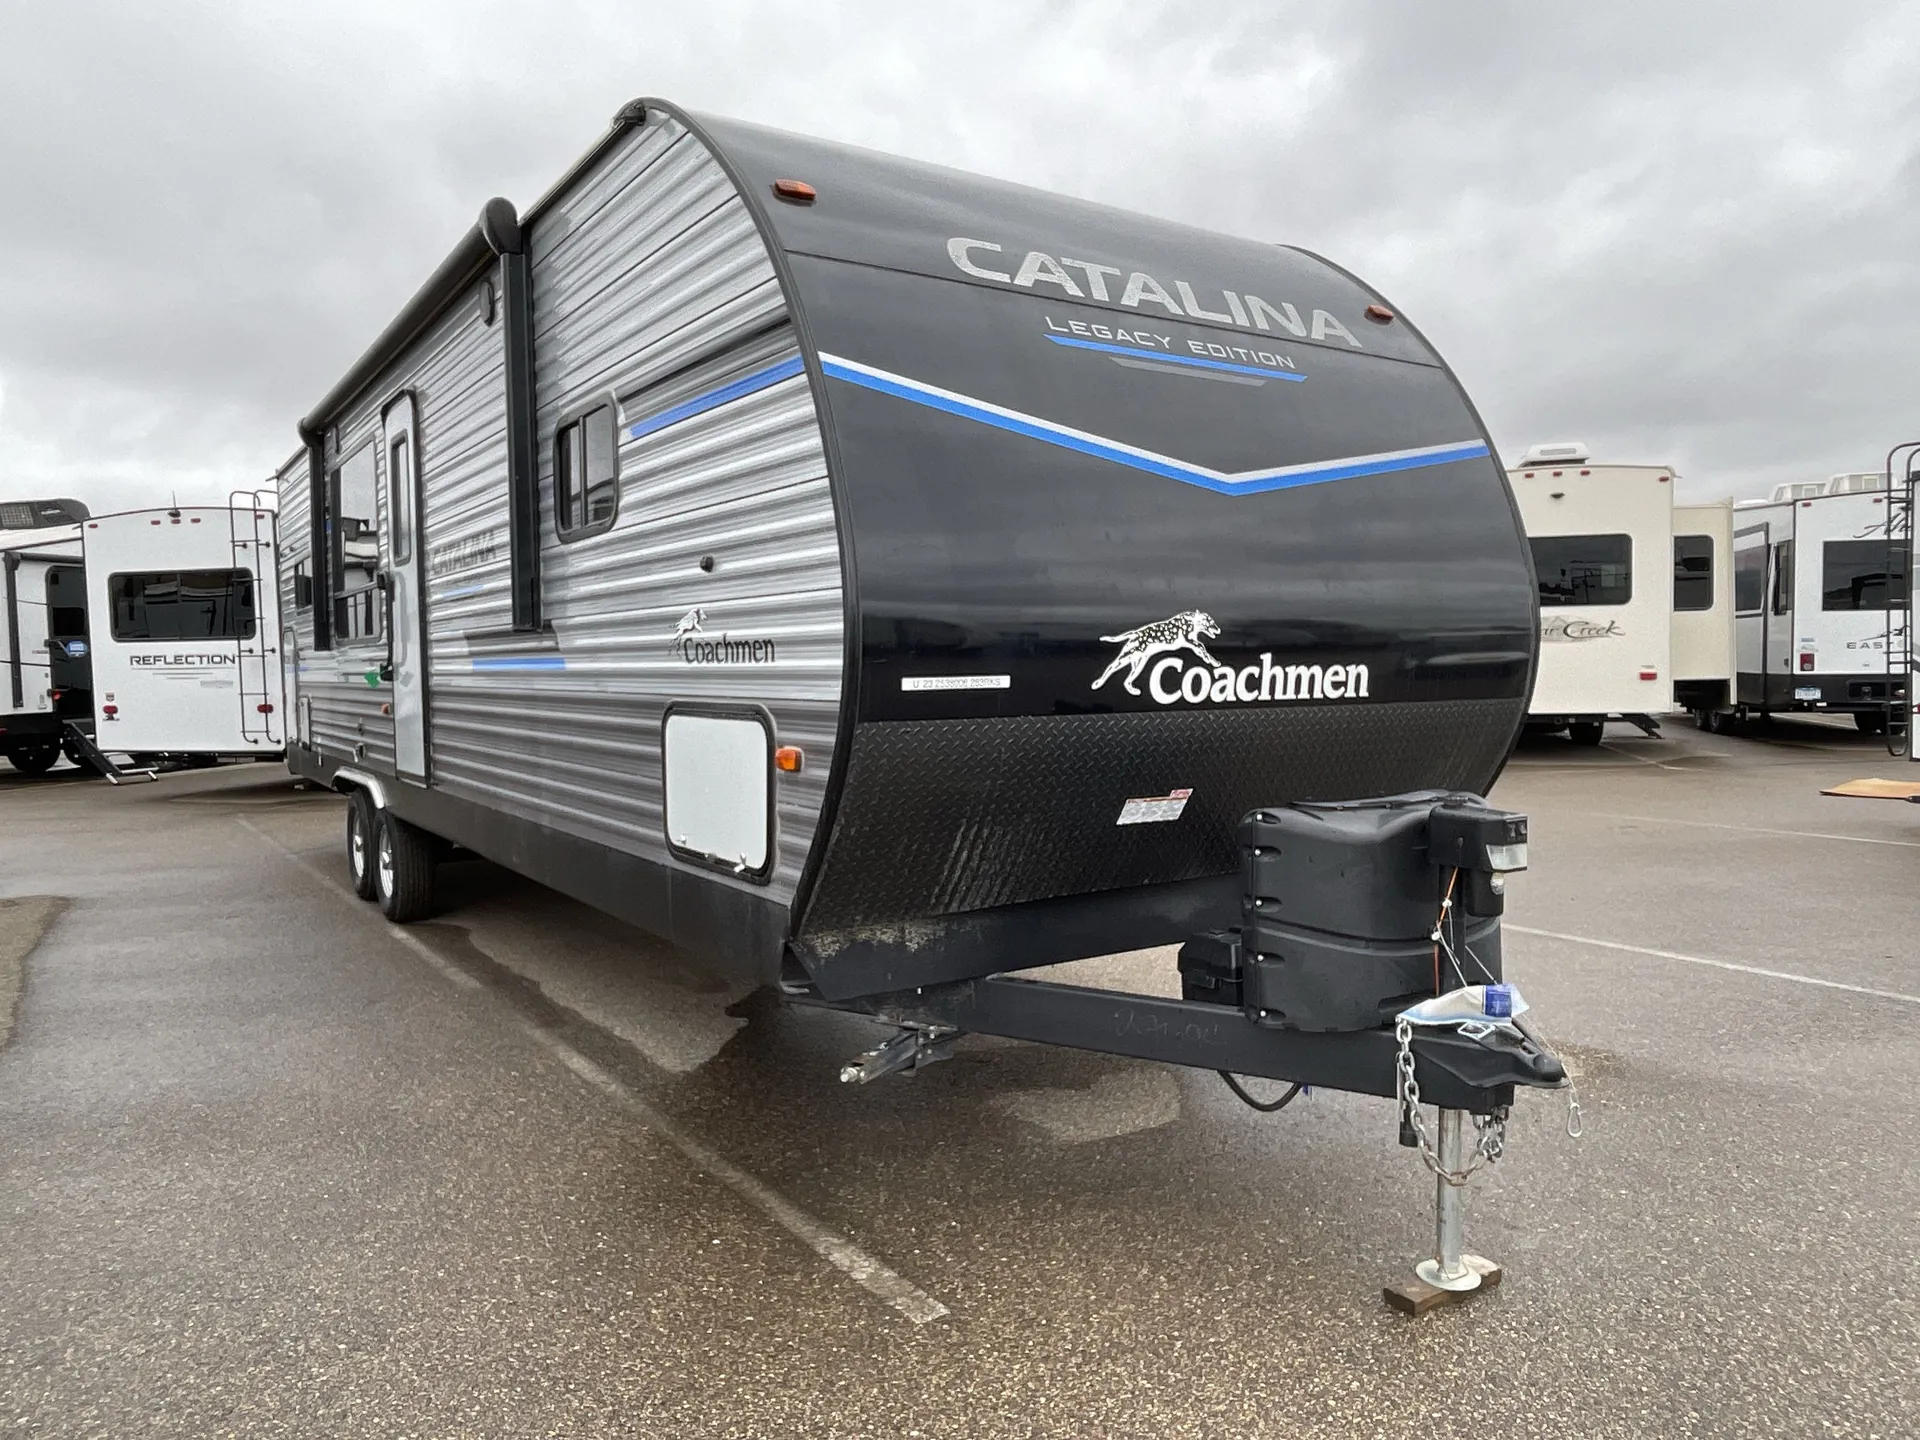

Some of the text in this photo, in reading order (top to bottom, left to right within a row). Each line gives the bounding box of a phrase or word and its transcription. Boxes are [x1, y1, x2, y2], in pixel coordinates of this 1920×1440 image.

[947, 237, 1362, 348] CATALINA
[1045, 317, 1296, 369] LEGACY EDITION
[130, 653, 236, 665] REFLECTION
[684, 633, 775, 664] Coachmen
[1149, 652, 1369, 704] Coachmen
